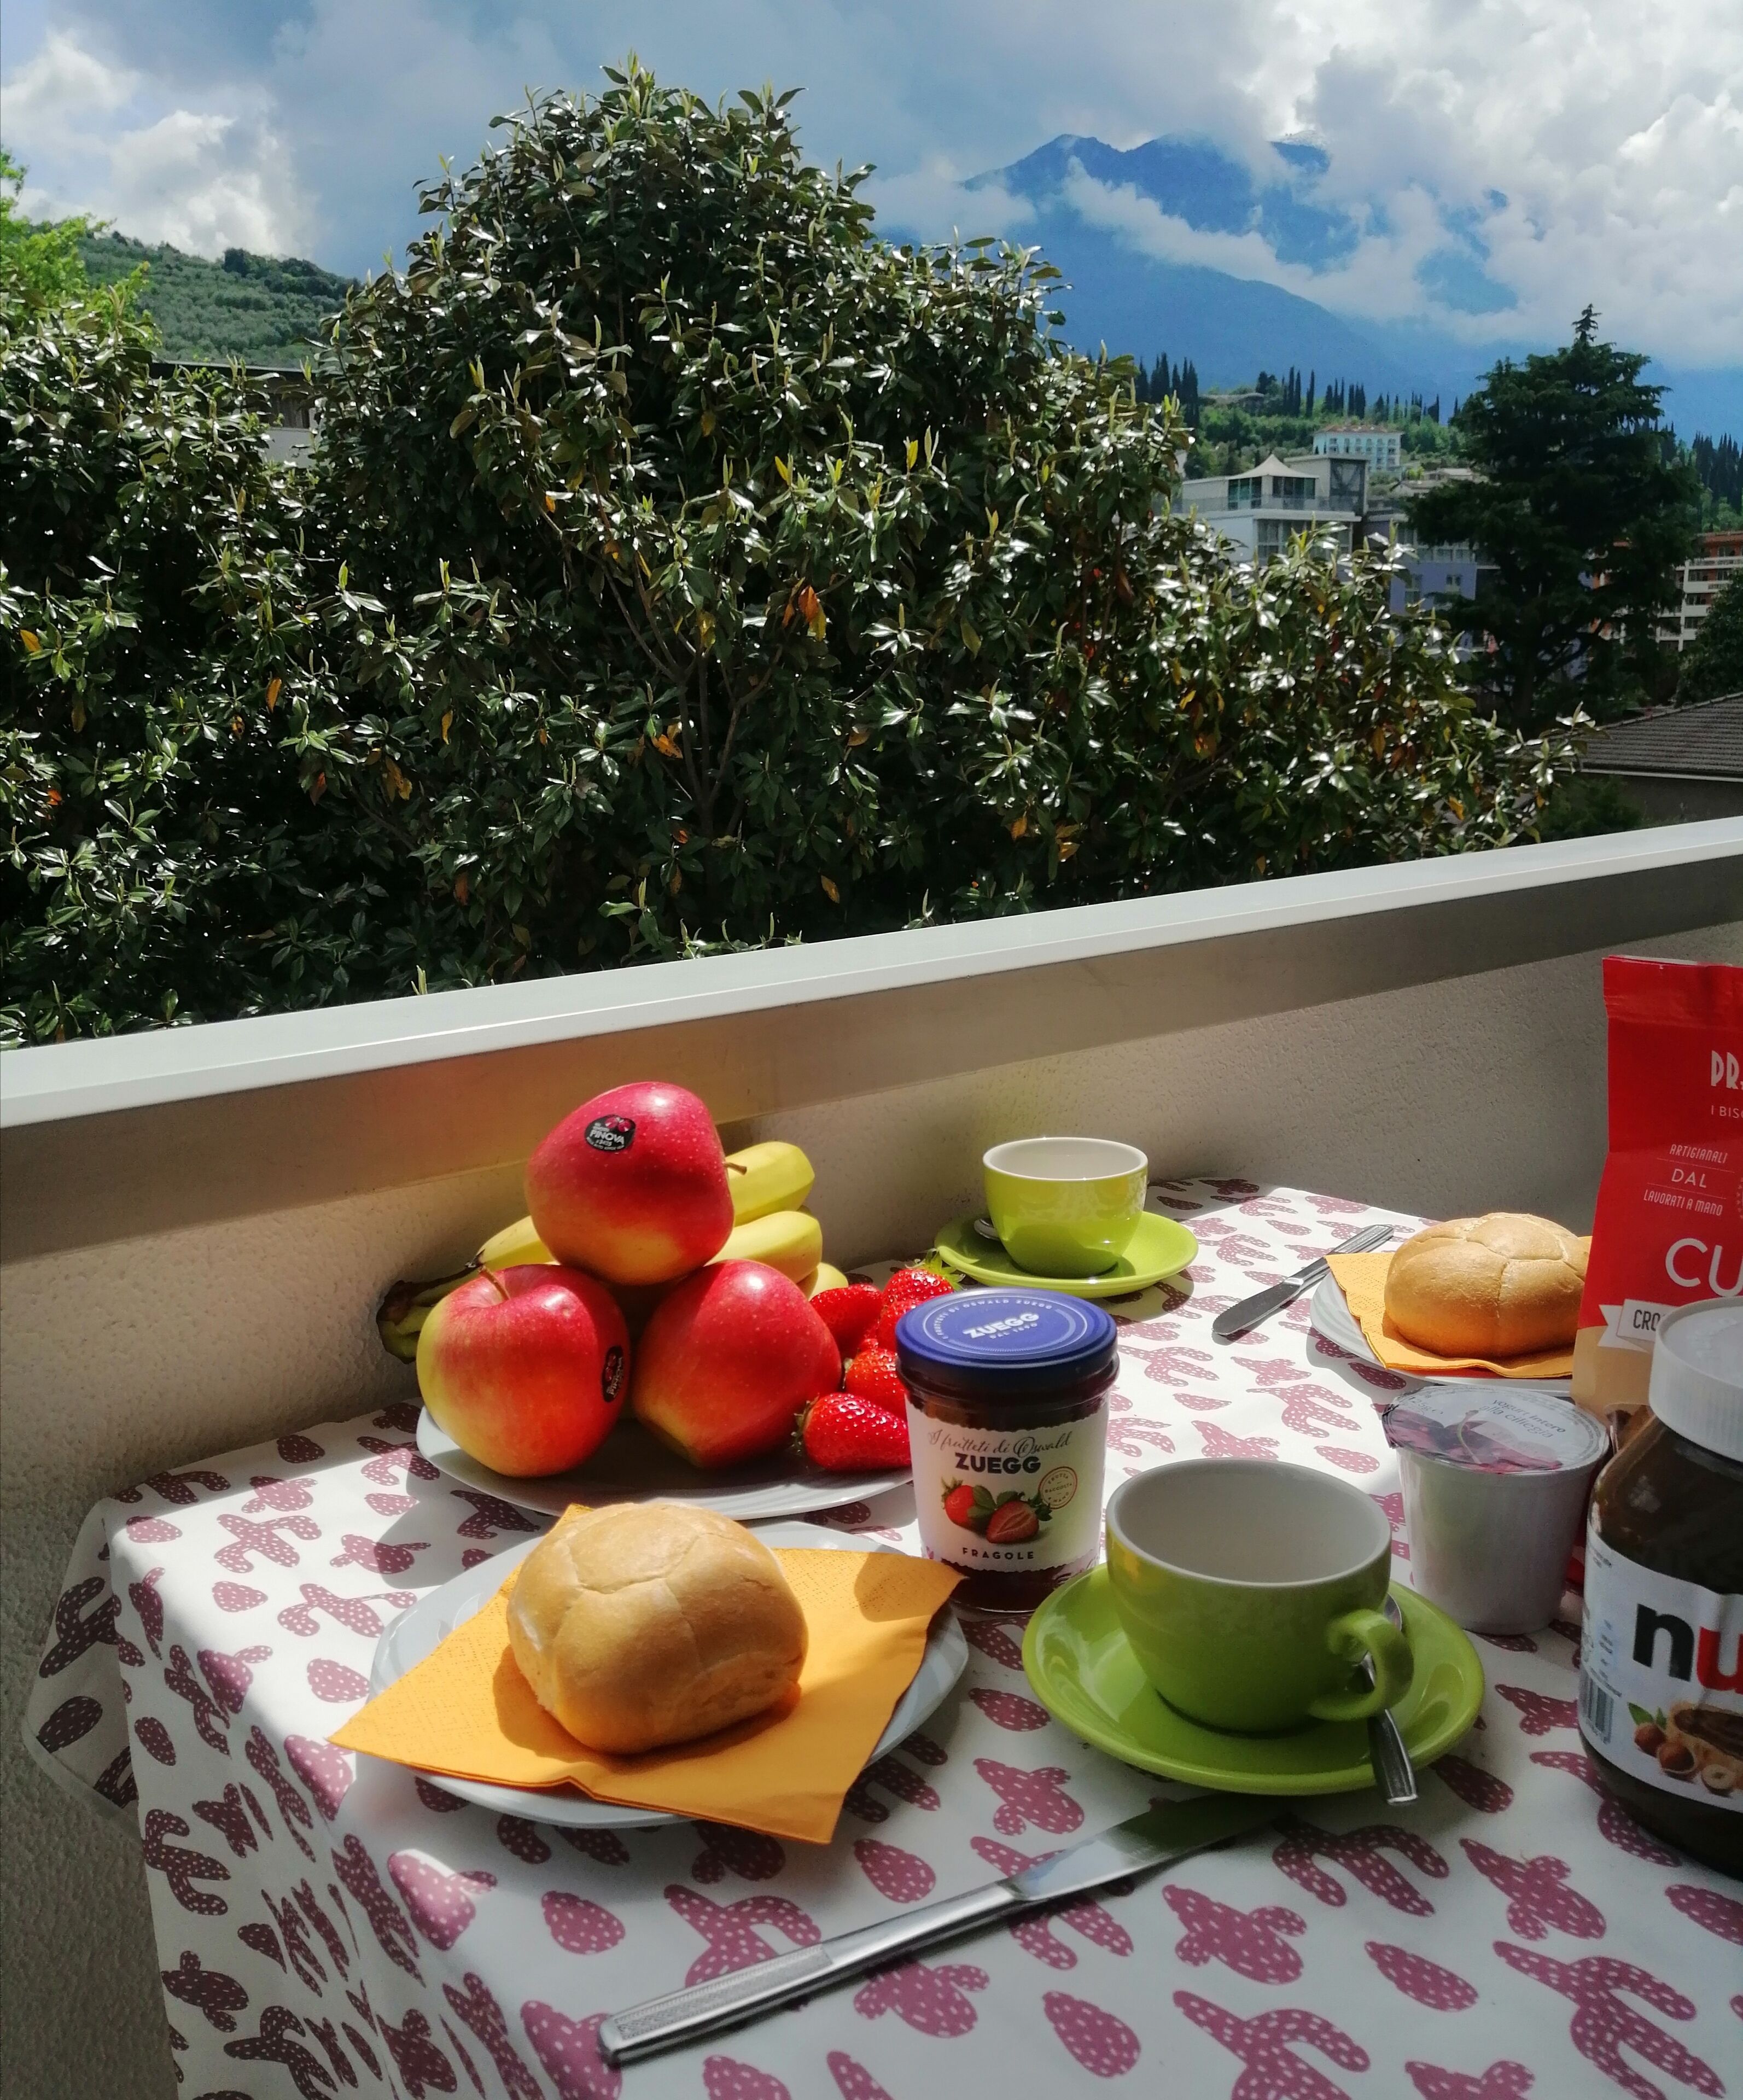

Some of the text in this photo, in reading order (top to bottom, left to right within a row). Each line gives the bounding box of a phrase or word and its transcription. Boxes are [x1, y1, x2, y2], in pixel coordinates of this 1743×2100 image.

[1711, 1050, 1743, 1090] PR
[1719, 1106, 1743, 1118] BIS
[590, 1129, 625, 1145] PINOVA
[1670, 1144, 1728, 1164] ARTIGIANALI
[1671, 1168, 1707, 1188] DAL
[1643, 1189, 1723, 1216] LAVORATI A MANO
[963, 1299, 1010, 1308] OSWALD
[1016, 1300, 1053, 1310] ZUEGG
[963, 1313, 1039, 1339] ZUEGG
[989, 1331, 1010, 1339] DAL
[1479, 1405, 1504, 1415] alla
[1505, 1414, 1554, 1438] ciliegia
[1493, 1399, 1530, 1416] yogurt
[1529, 1415, 1566, 1433] intero
[941, 1432, 990, 1453] frutteti
[993, 1439, 1011, 1454] di
[1013, 1431, 1072, 1457] Oswald
[955, 1452, 1041, 1474] ZUEGG
[1045, 1483, 1072, 1494] RACCOLTA
[963, 1547, 1034, 1559] FRAGOLE
